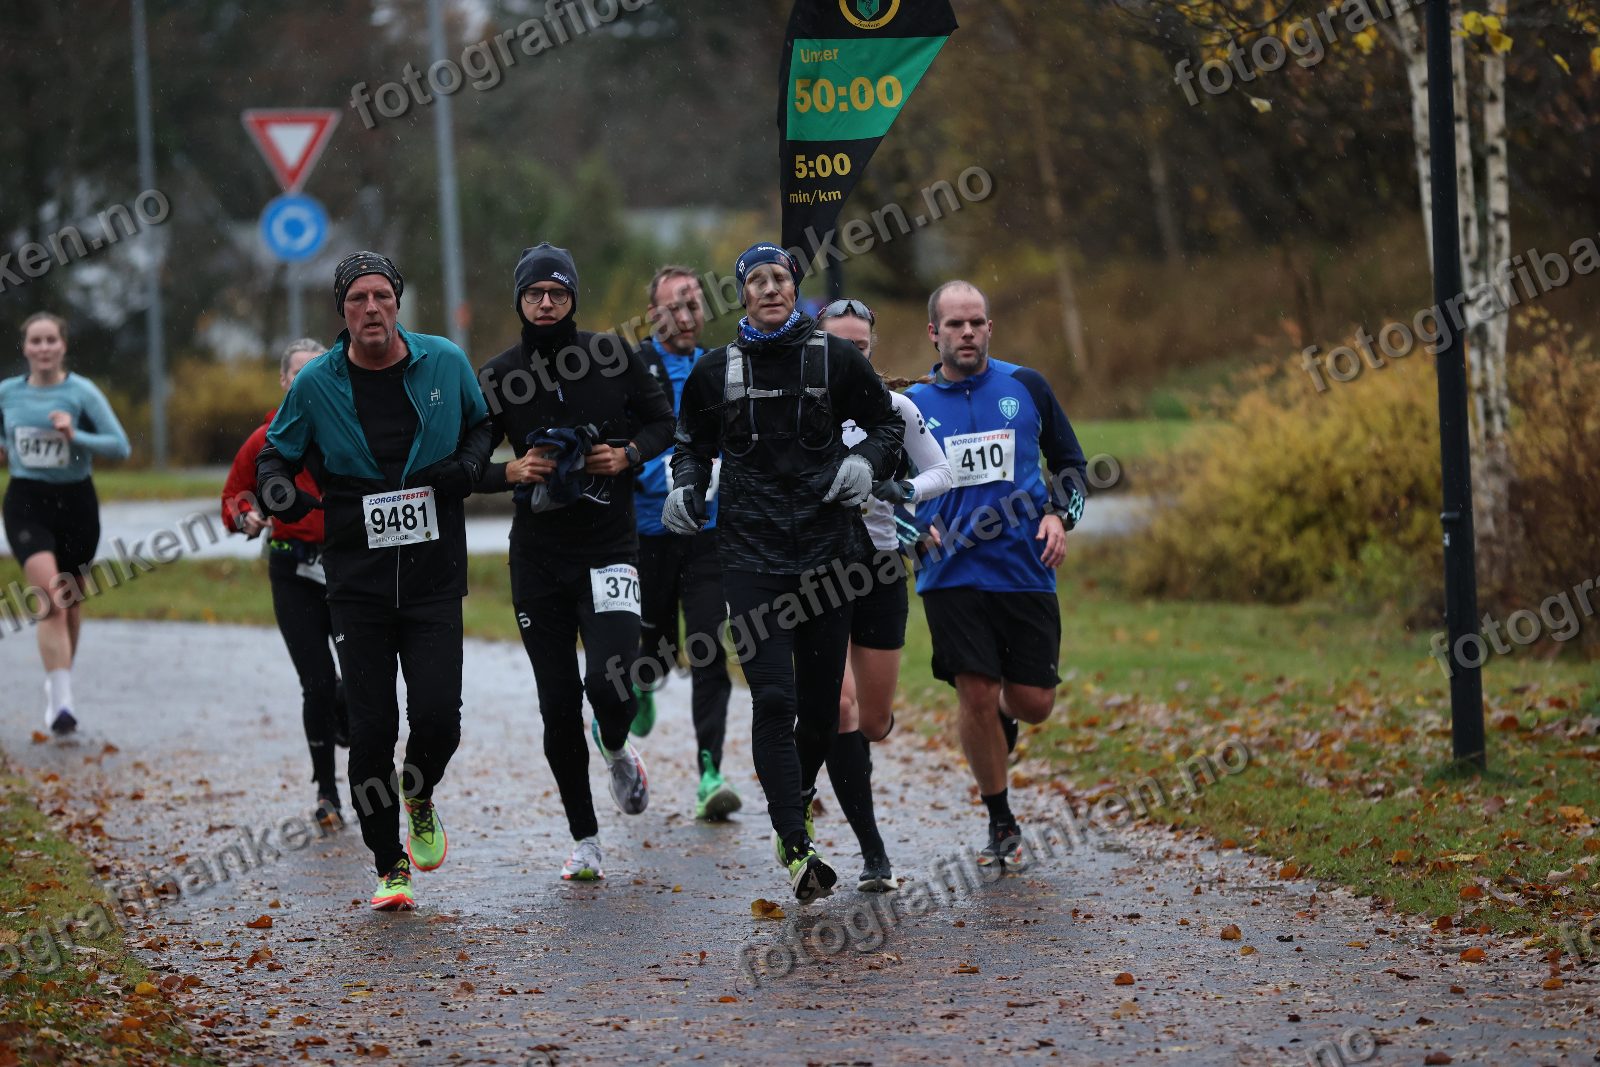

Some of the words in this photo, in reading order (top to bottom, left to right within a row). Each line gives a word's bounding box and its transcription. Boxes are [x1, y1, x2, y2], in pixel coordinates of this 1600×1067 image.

[794, 75, 903, 113] 50:00
[795, 152, 852, 179] 5:00
[789, 189, 842, 206] min/km
[20, 438, 63, 457] 9477
[962, 443, 1004, 472] 410
[371, 501, 428, 535] 9481
[605, 576, 640, 604] 370
